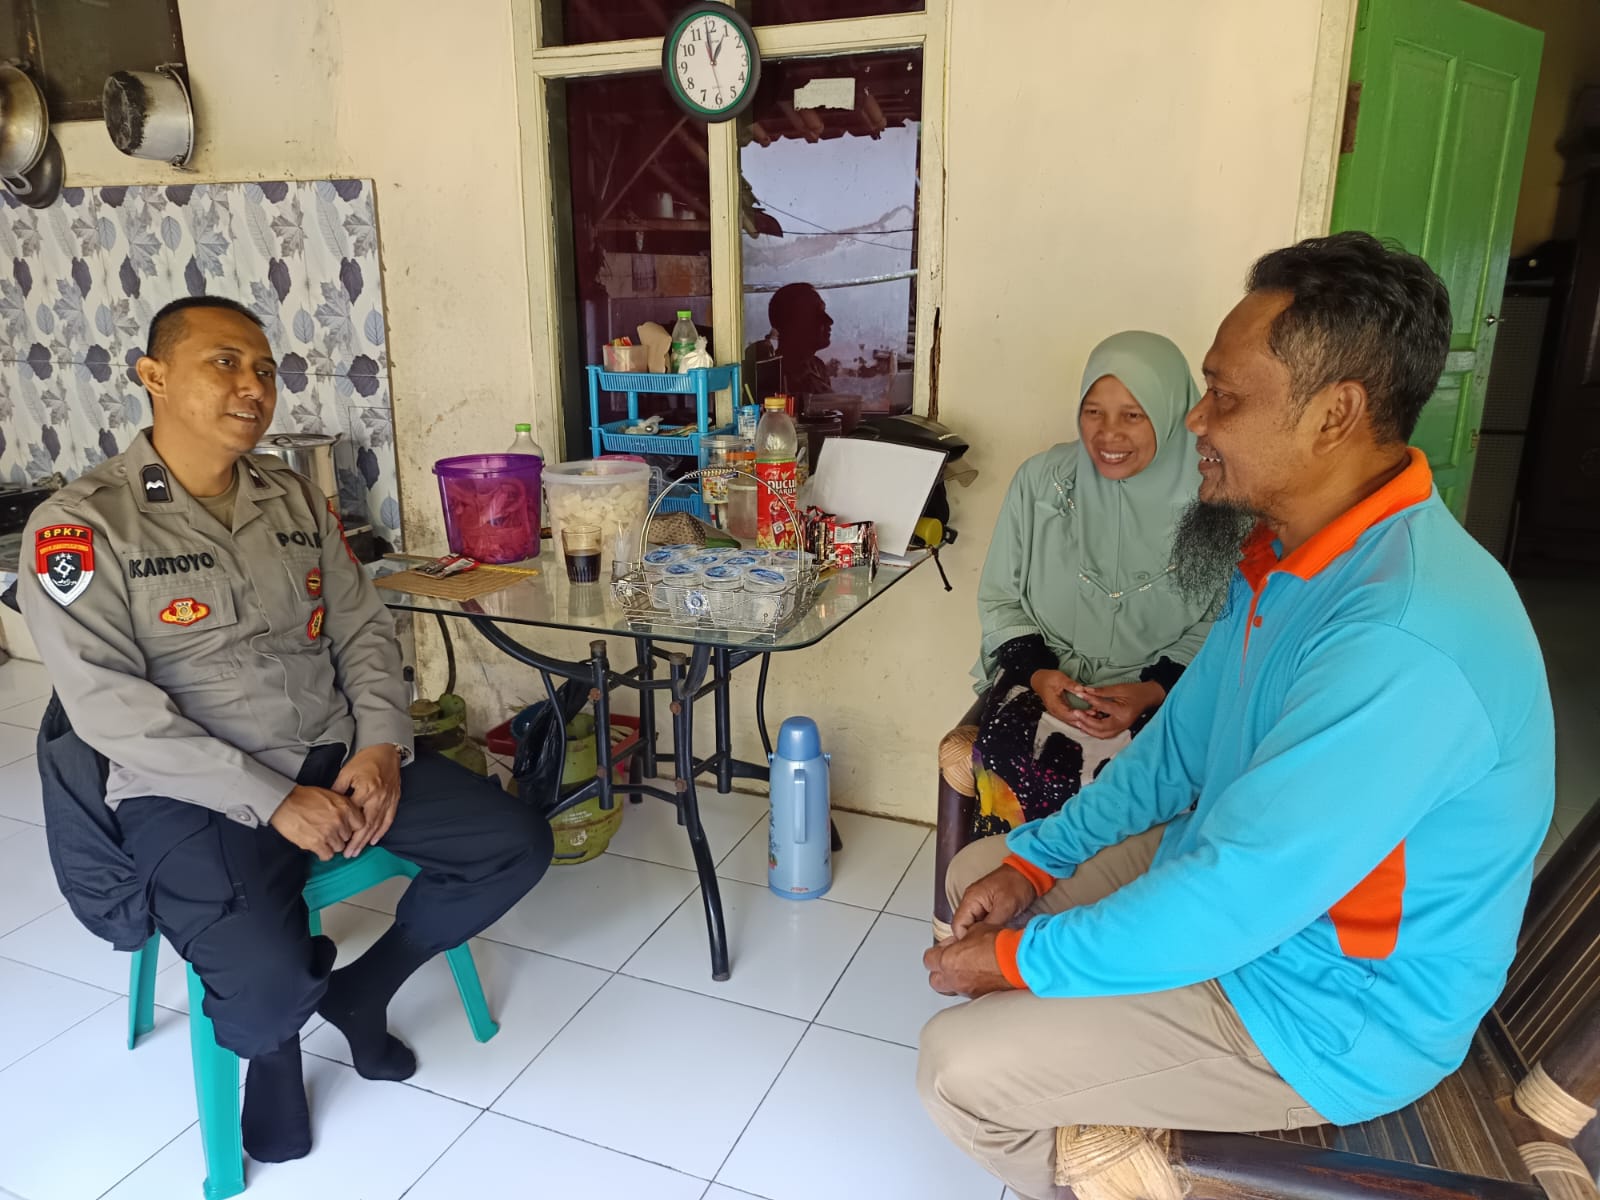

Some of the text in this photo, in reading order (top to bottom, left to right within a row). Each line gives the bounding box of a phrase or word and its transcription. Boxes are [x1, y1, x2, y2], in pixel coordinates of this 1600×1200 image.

[690, 28, 702, 42] 11
[723, 24, 729, 38] 1
[734, 35, 743, 49] 2
[683, 43, 695, 57] 10
[680, 61, 688, 74] 9
[741, 54, 748, 68] 3
[687, 76, 695, 90] 8
[738, 71, 745, 84] 4
[700, 89, 707, 102] 7
[715, 92, 723, 106] 6
[730, 86, 737, 99] 5
[43, 527, 85, 539] SPKT
[129, 552, 215, 579] KARTOYO
